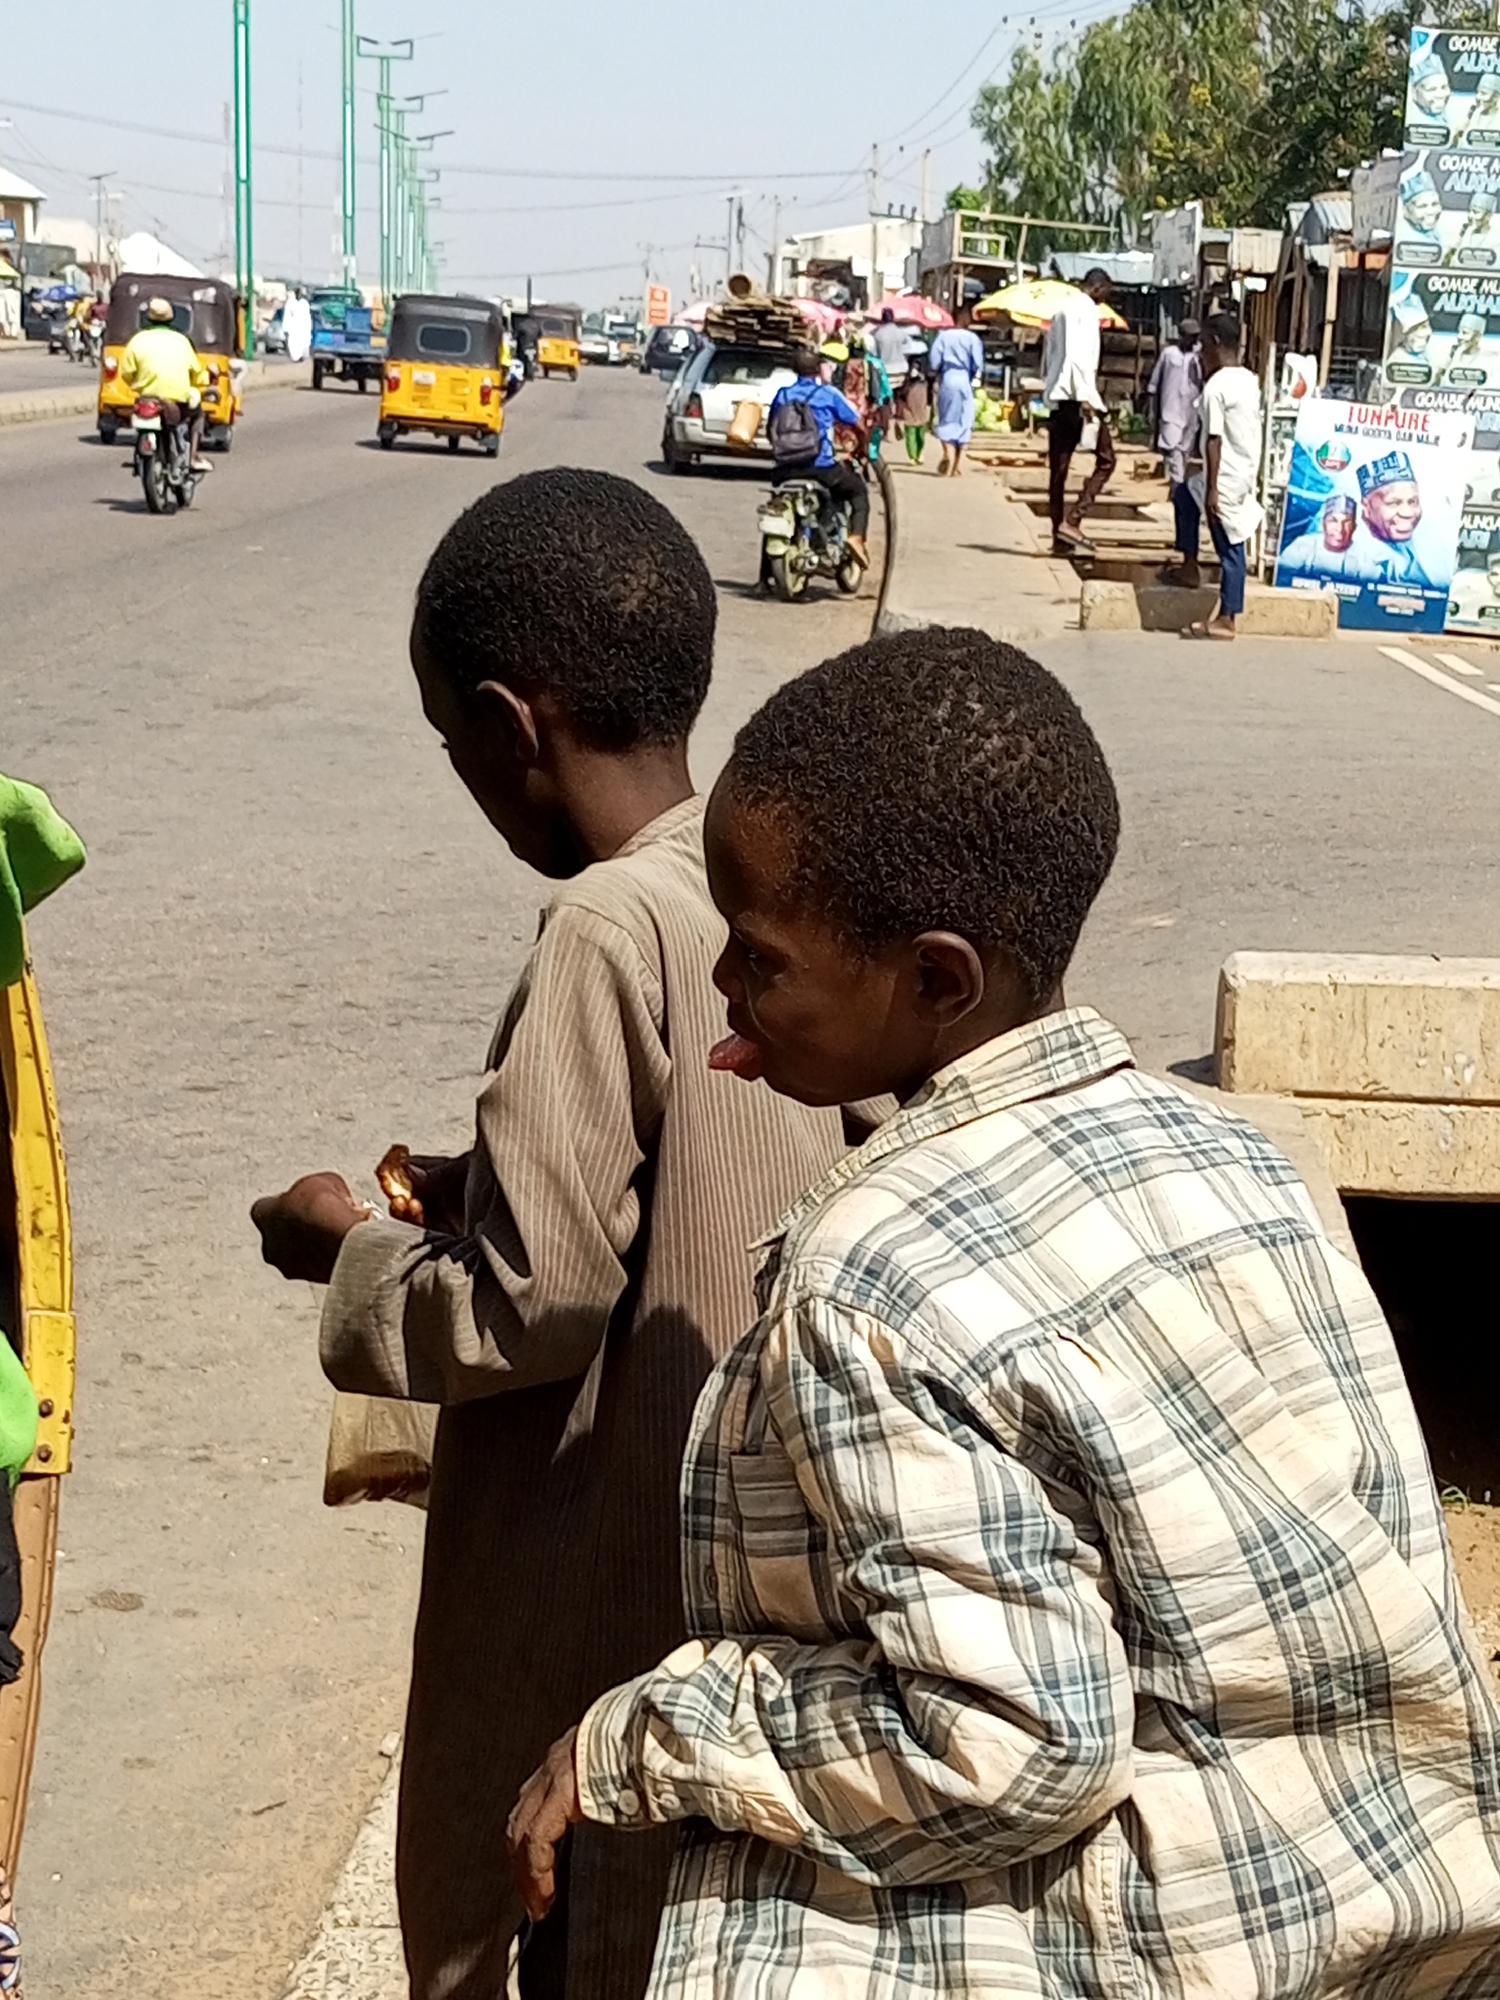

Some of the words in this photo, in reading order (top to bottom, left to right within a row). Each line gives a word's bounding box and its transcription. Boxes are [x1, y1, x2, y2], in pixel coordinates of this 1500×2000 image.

[1448, 35, 1499, 53] GOMBE
[1439, 154, 1490, 173] GOMBE
[1427, 275, 1479, 295] GOMBE
[1414, 391, 1465, 409] GOMBE
